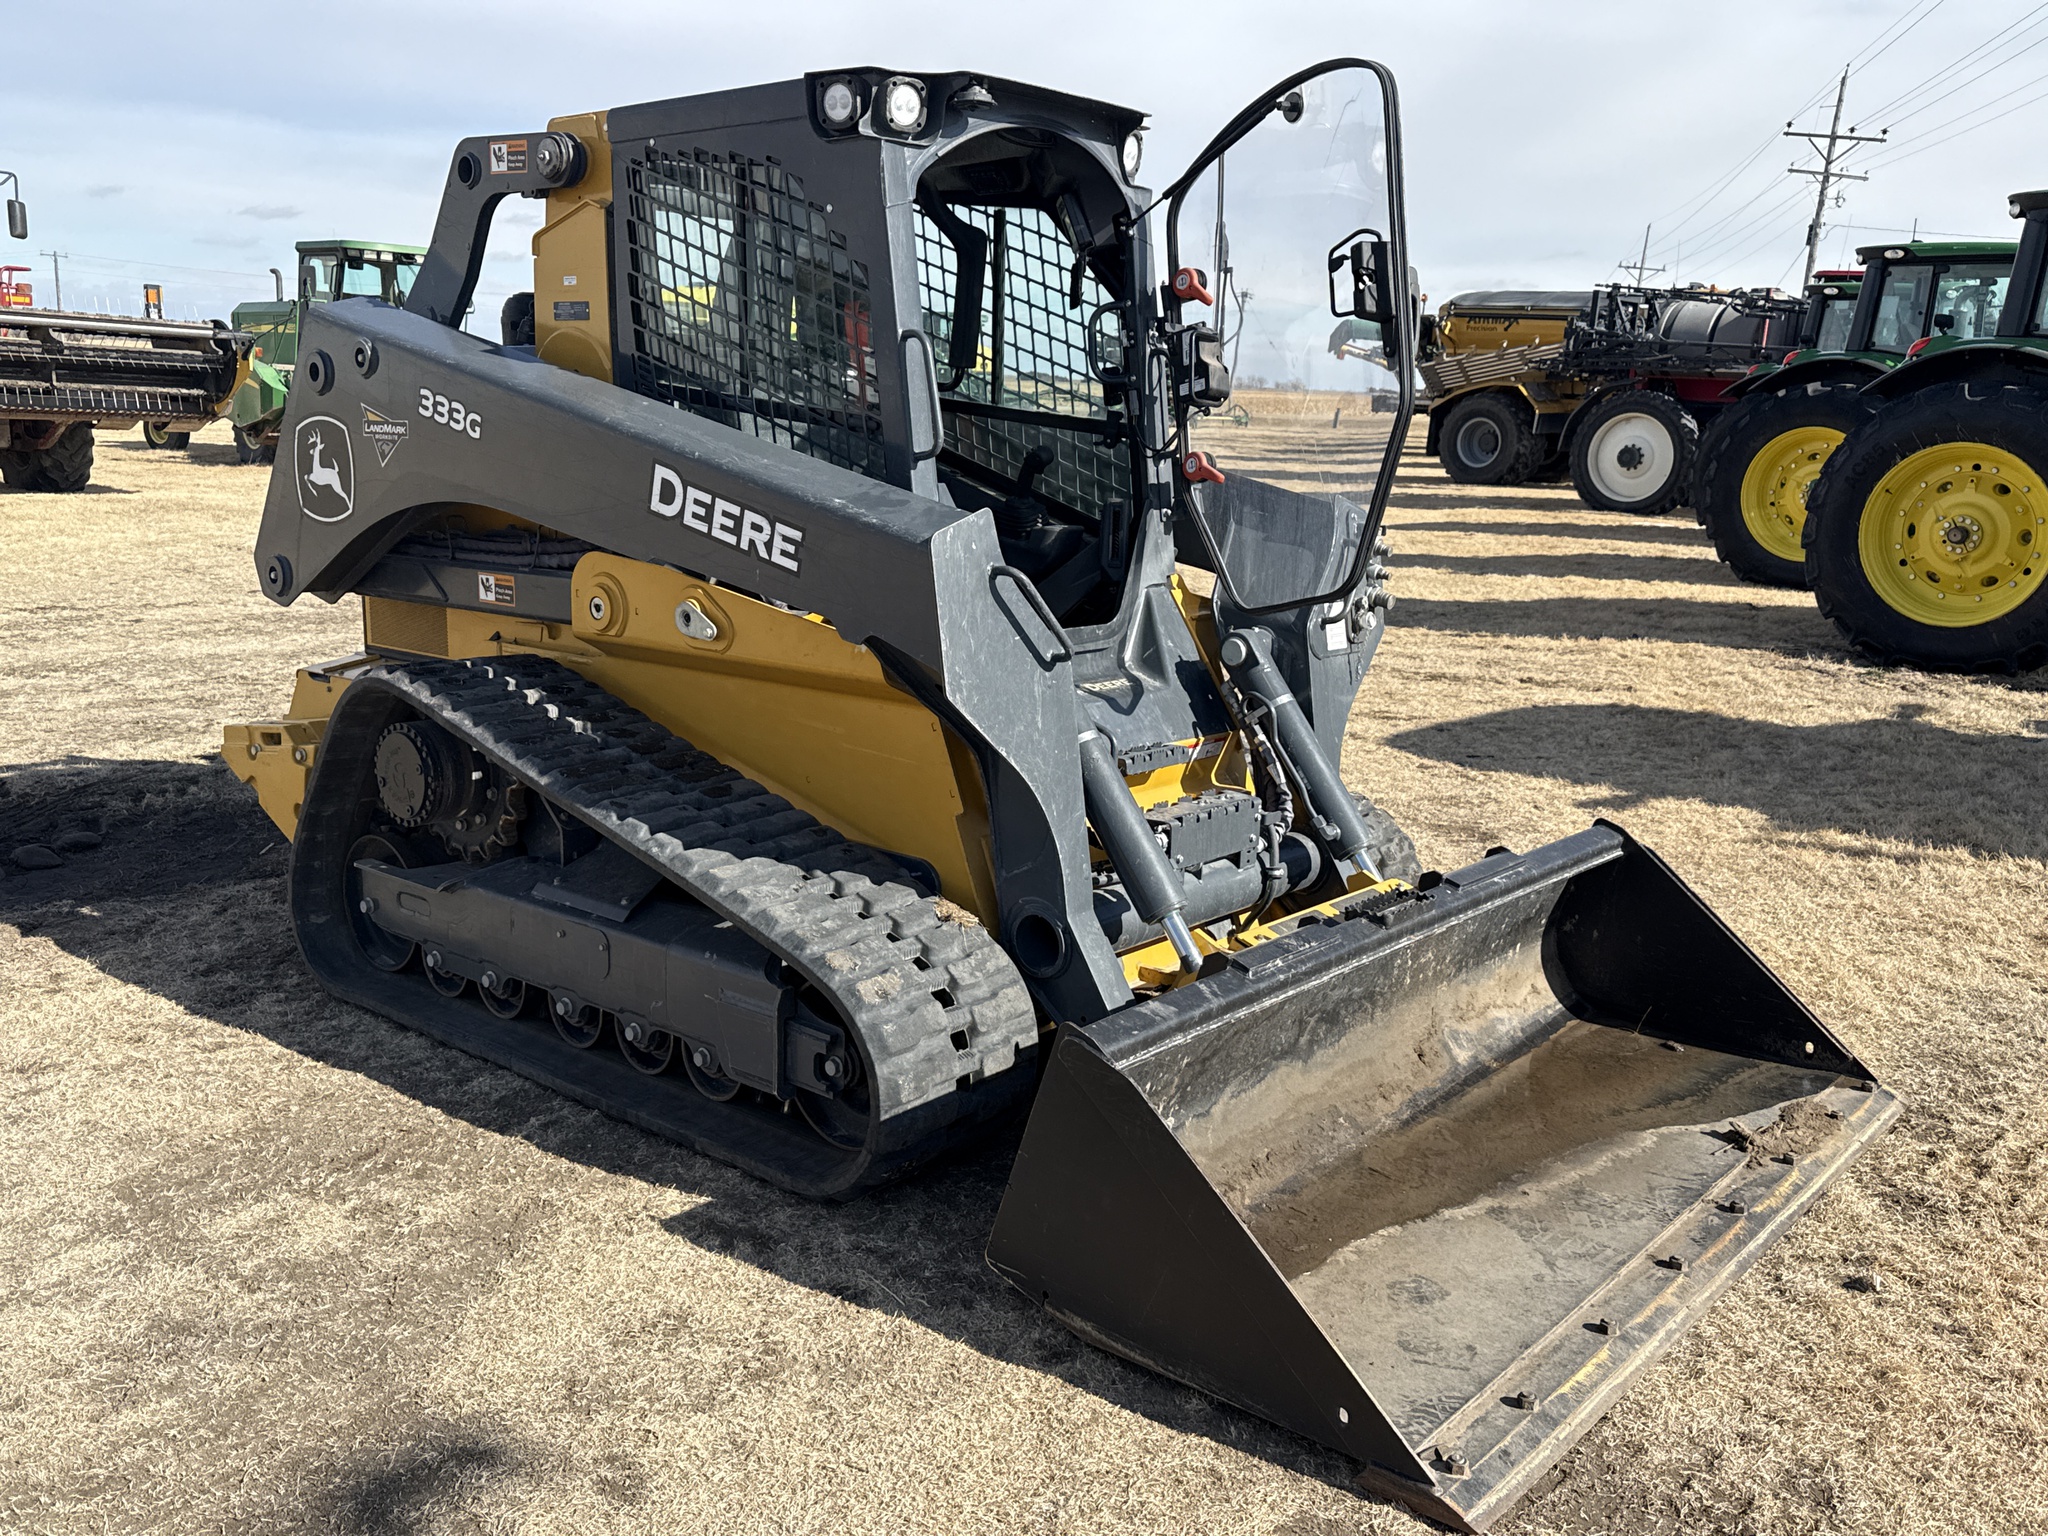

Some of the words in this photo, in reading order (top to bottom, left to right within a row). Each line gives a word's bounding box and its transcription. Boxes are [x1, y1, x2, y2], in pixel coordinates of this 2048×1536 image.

[418, 388, 482, 439] 333G
[650, 463, 803, 572] DEERE
[1081, 678, 1134, 691] DEERE
